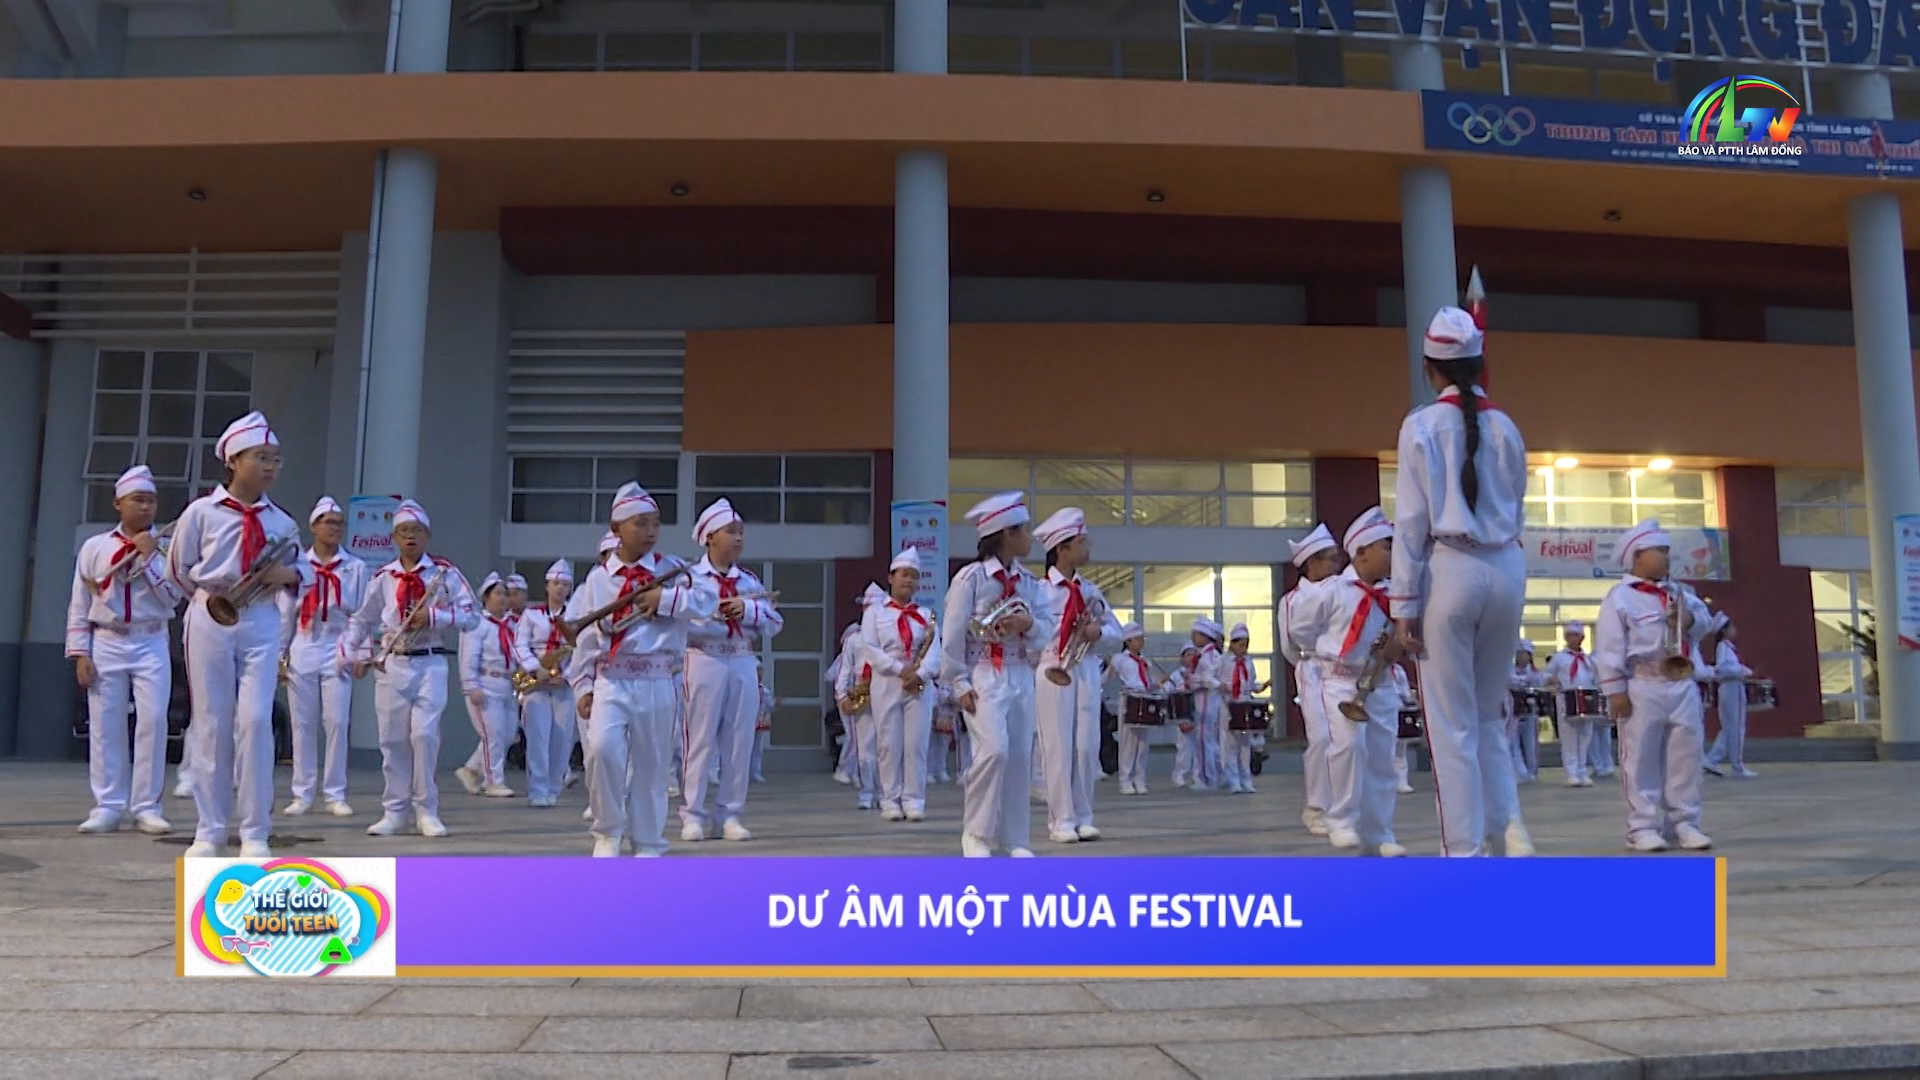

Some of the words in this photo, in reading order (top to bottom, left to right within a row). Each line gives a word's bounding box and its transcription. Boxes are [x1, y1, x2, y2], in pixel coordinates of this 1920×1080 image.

[1543, 122, 1611, 142] TRUNG
[1613, 125, 1657, 145] TÂM
[1810, 138, 1841, 156] THI
[352, 535, 393, 549] Festival
[1540, 538, 1593, 558] Festival
